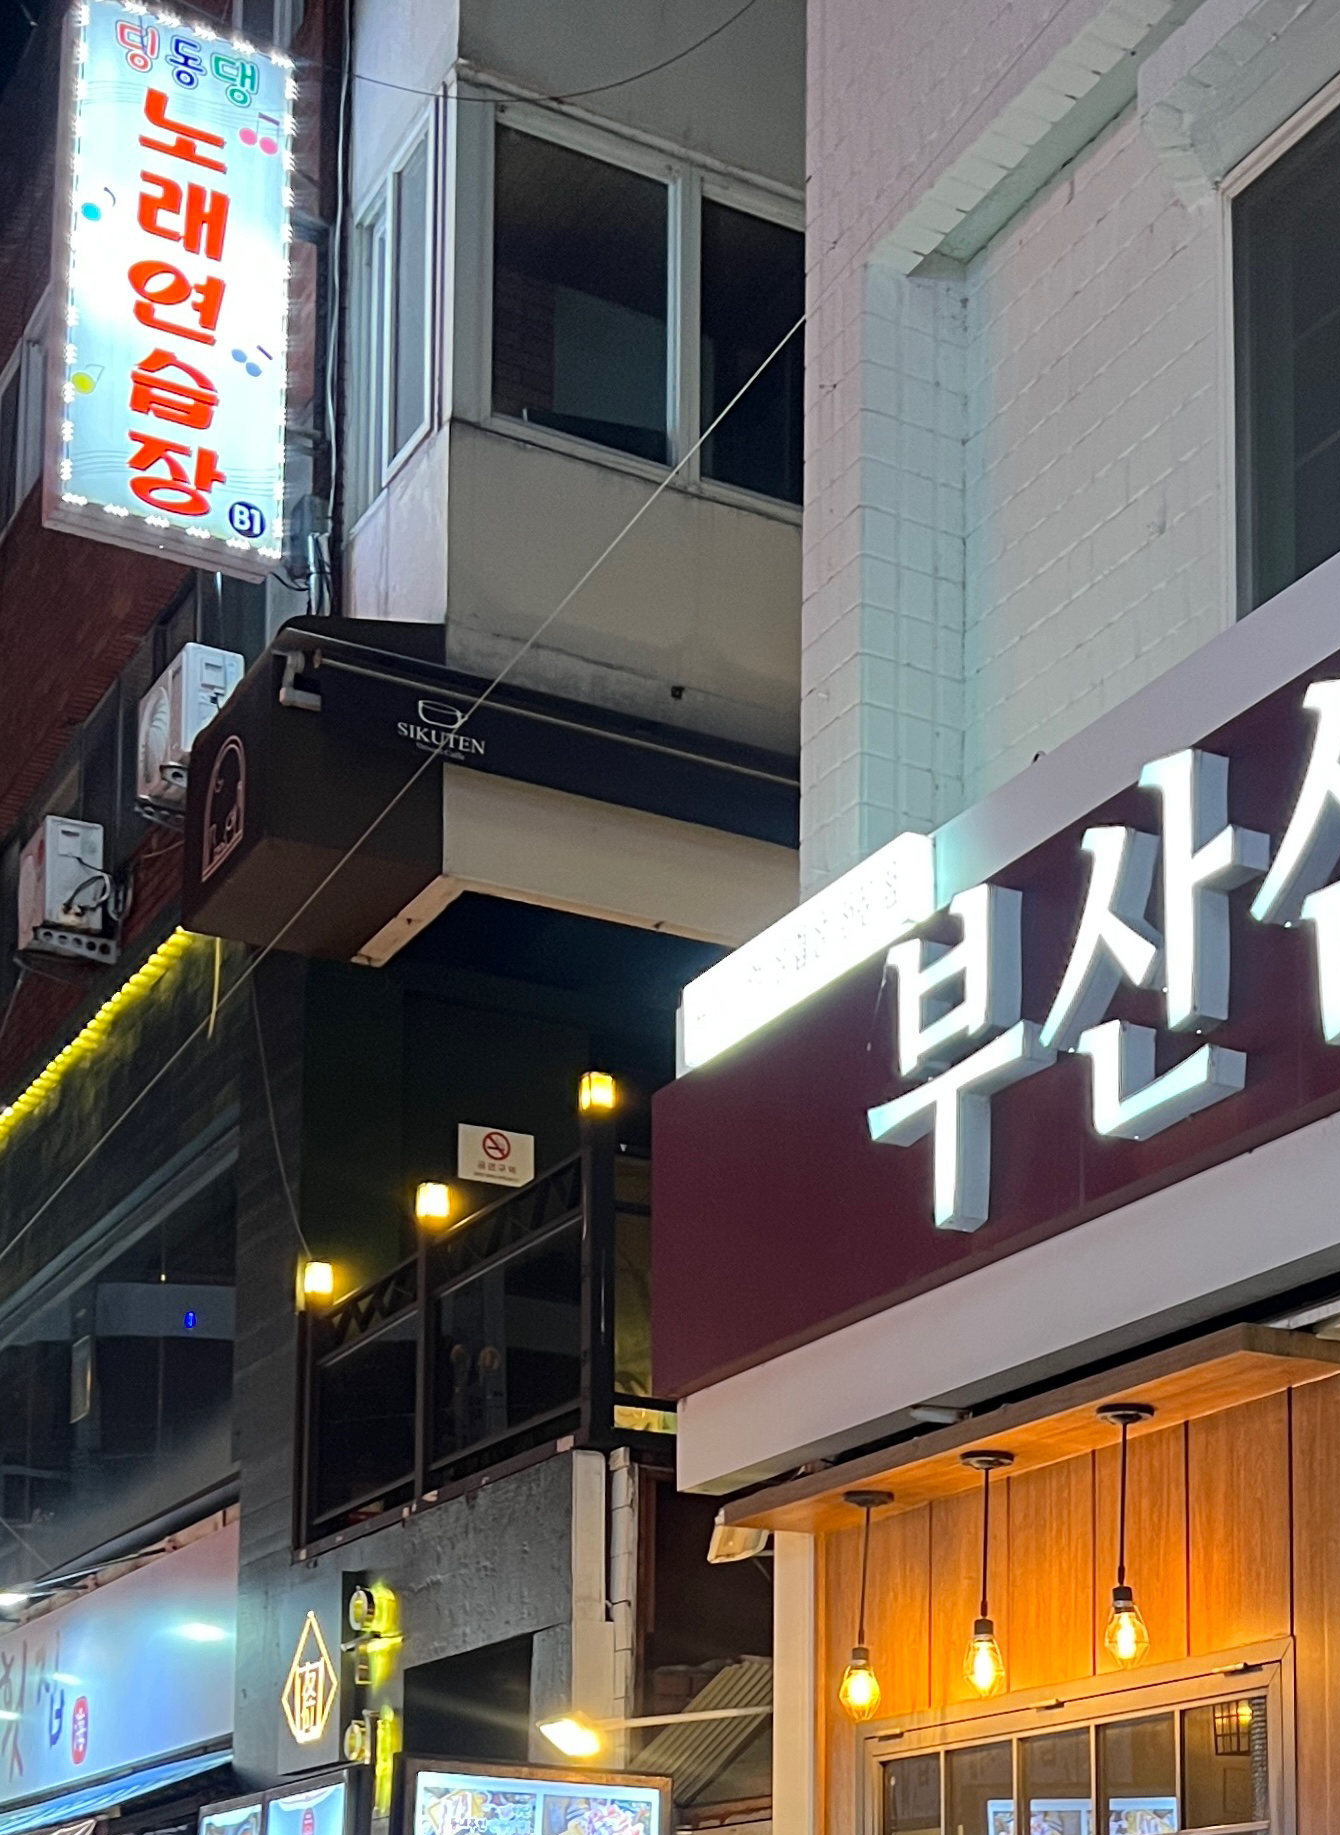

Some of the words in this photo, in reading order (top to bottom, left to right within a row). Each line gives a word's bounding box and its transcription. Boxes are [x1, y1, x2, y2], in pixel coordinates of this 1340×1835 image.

[116, 20, 260, 108] 딩동댕
[127, 86, 230, 517] 노래연습장
[232, 504, 263, 535] B1
[397, 721, 486, 755] SIKUTEN
